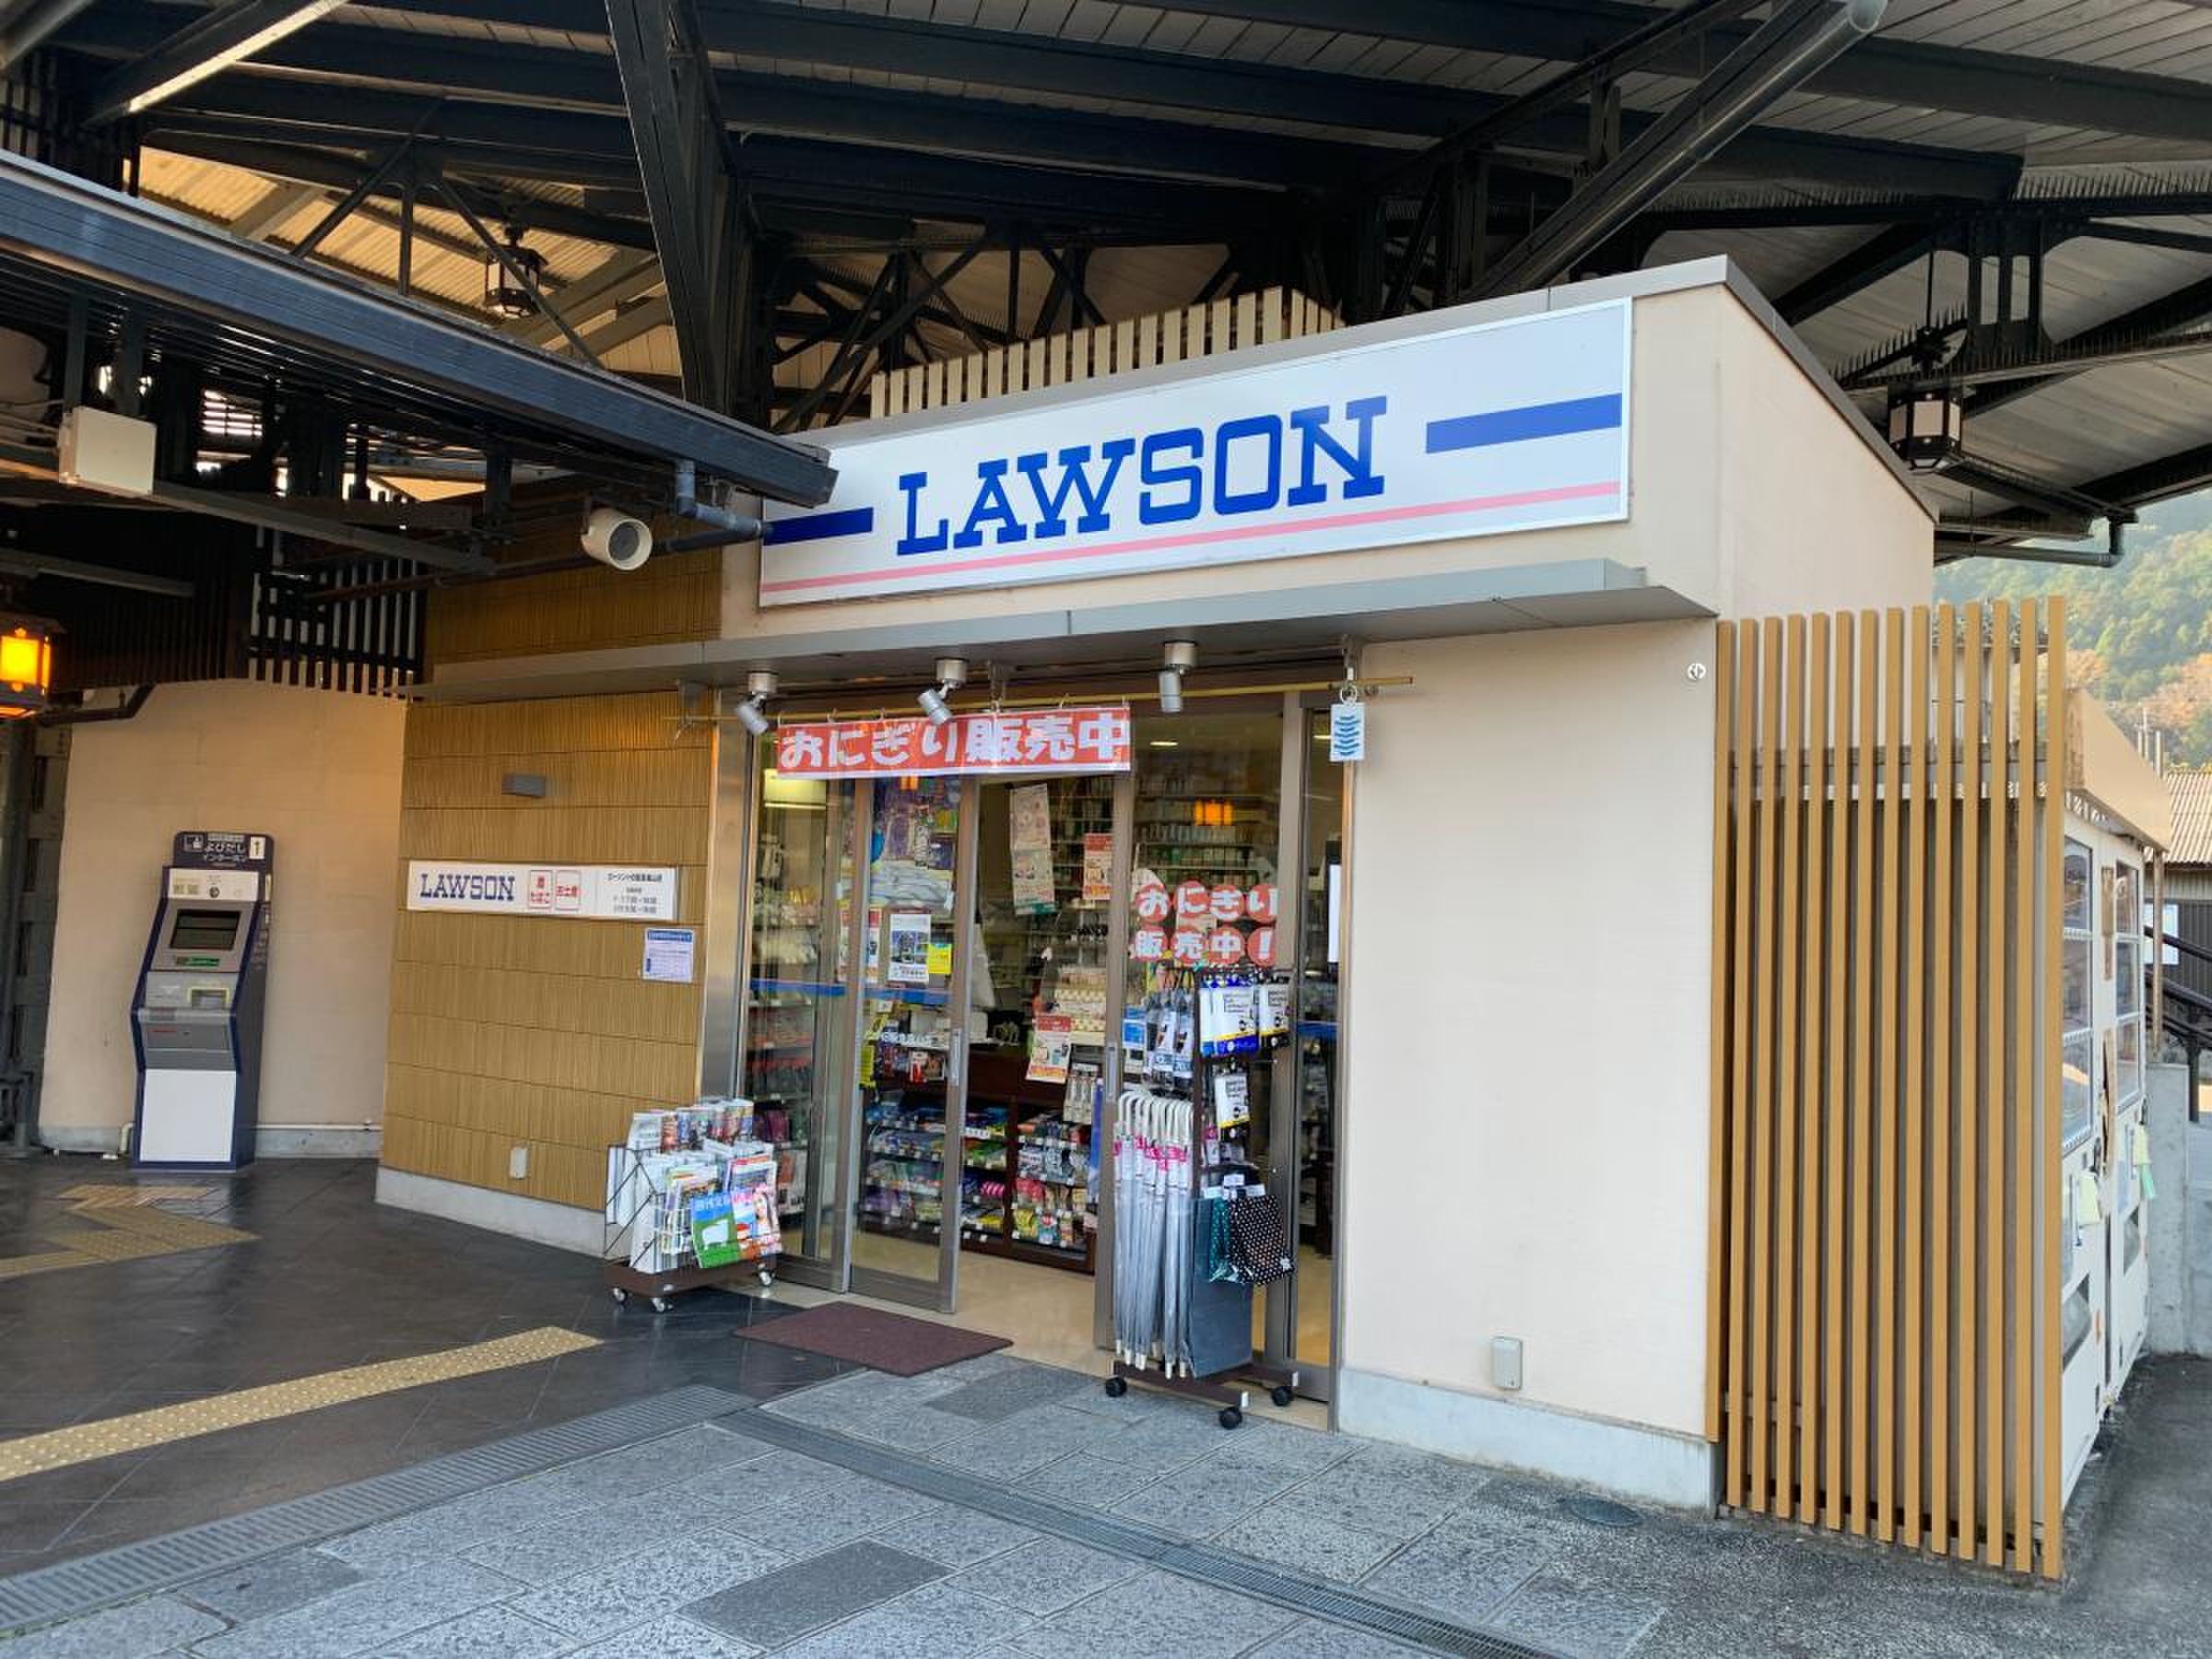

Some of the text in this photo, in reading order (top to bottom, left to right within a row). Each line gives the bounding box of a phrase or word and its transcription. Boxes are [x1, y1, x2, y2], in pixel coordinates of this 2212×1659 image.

[896, 396, 1387, 556] LAWSON
[780, 712, 1131, 768] おにぎり販売中
[419, 874, 515, 901] LAWSON
